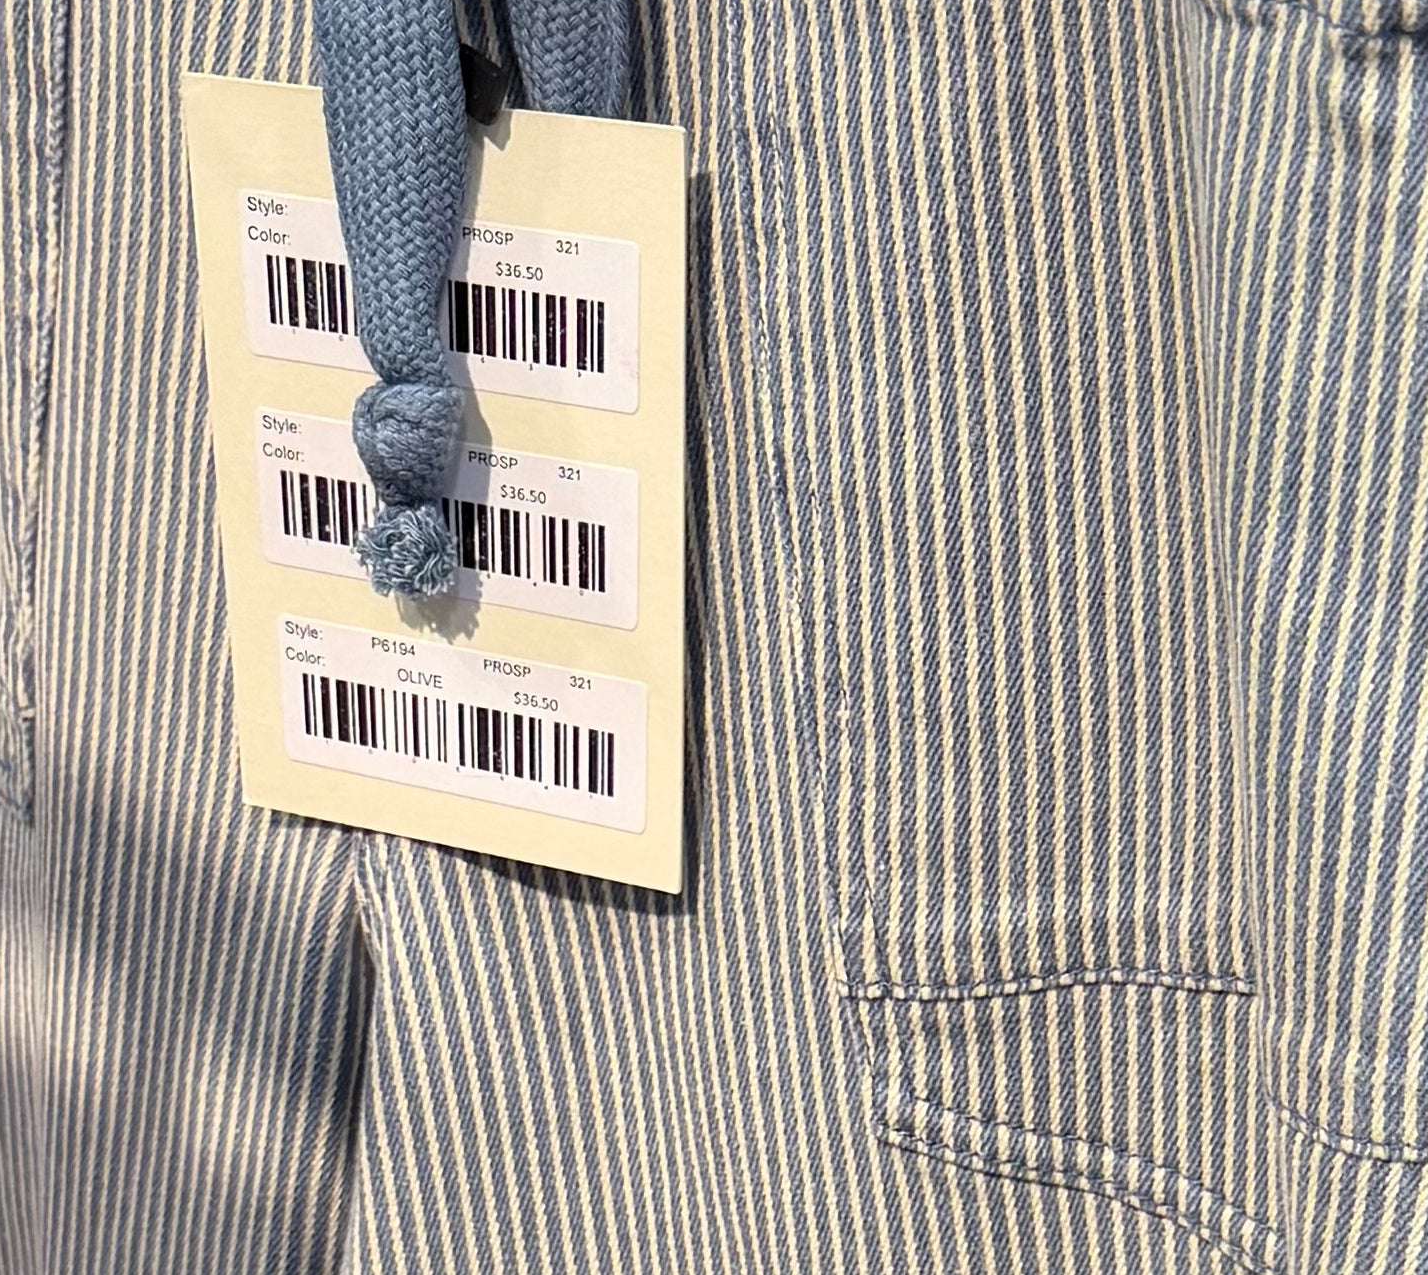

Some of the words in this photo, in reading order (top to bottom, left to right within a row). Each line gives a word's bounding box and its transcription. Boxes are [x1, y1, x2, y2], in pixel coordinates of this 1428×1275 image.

[247, 196, 288, 217] Style:
[462, 226, 514, 246] PROSP
[556, 239, 579, 255] 321
[248, 225, 291, 246] Color:
[495, 261, 544, 281] $36.50
[262, 415, 302, 434] Style:
[468, 450, 518, 469] PROSP
[558, 466, 581, 481] 321
[262, 442, 304, 462] Color:
[500, 484, 546, 504] $36.50
[285, 620, 324, 640] Style:
[371, 636, 415, 656] P6194
[483, 658, 531, 677] PROSP
[569, 675, 592, 690] 321
[285, 646, 326, 667] Color:
[397, 668, 443, 689] OLIVE
[513, 691, 559, 712] $36.50
